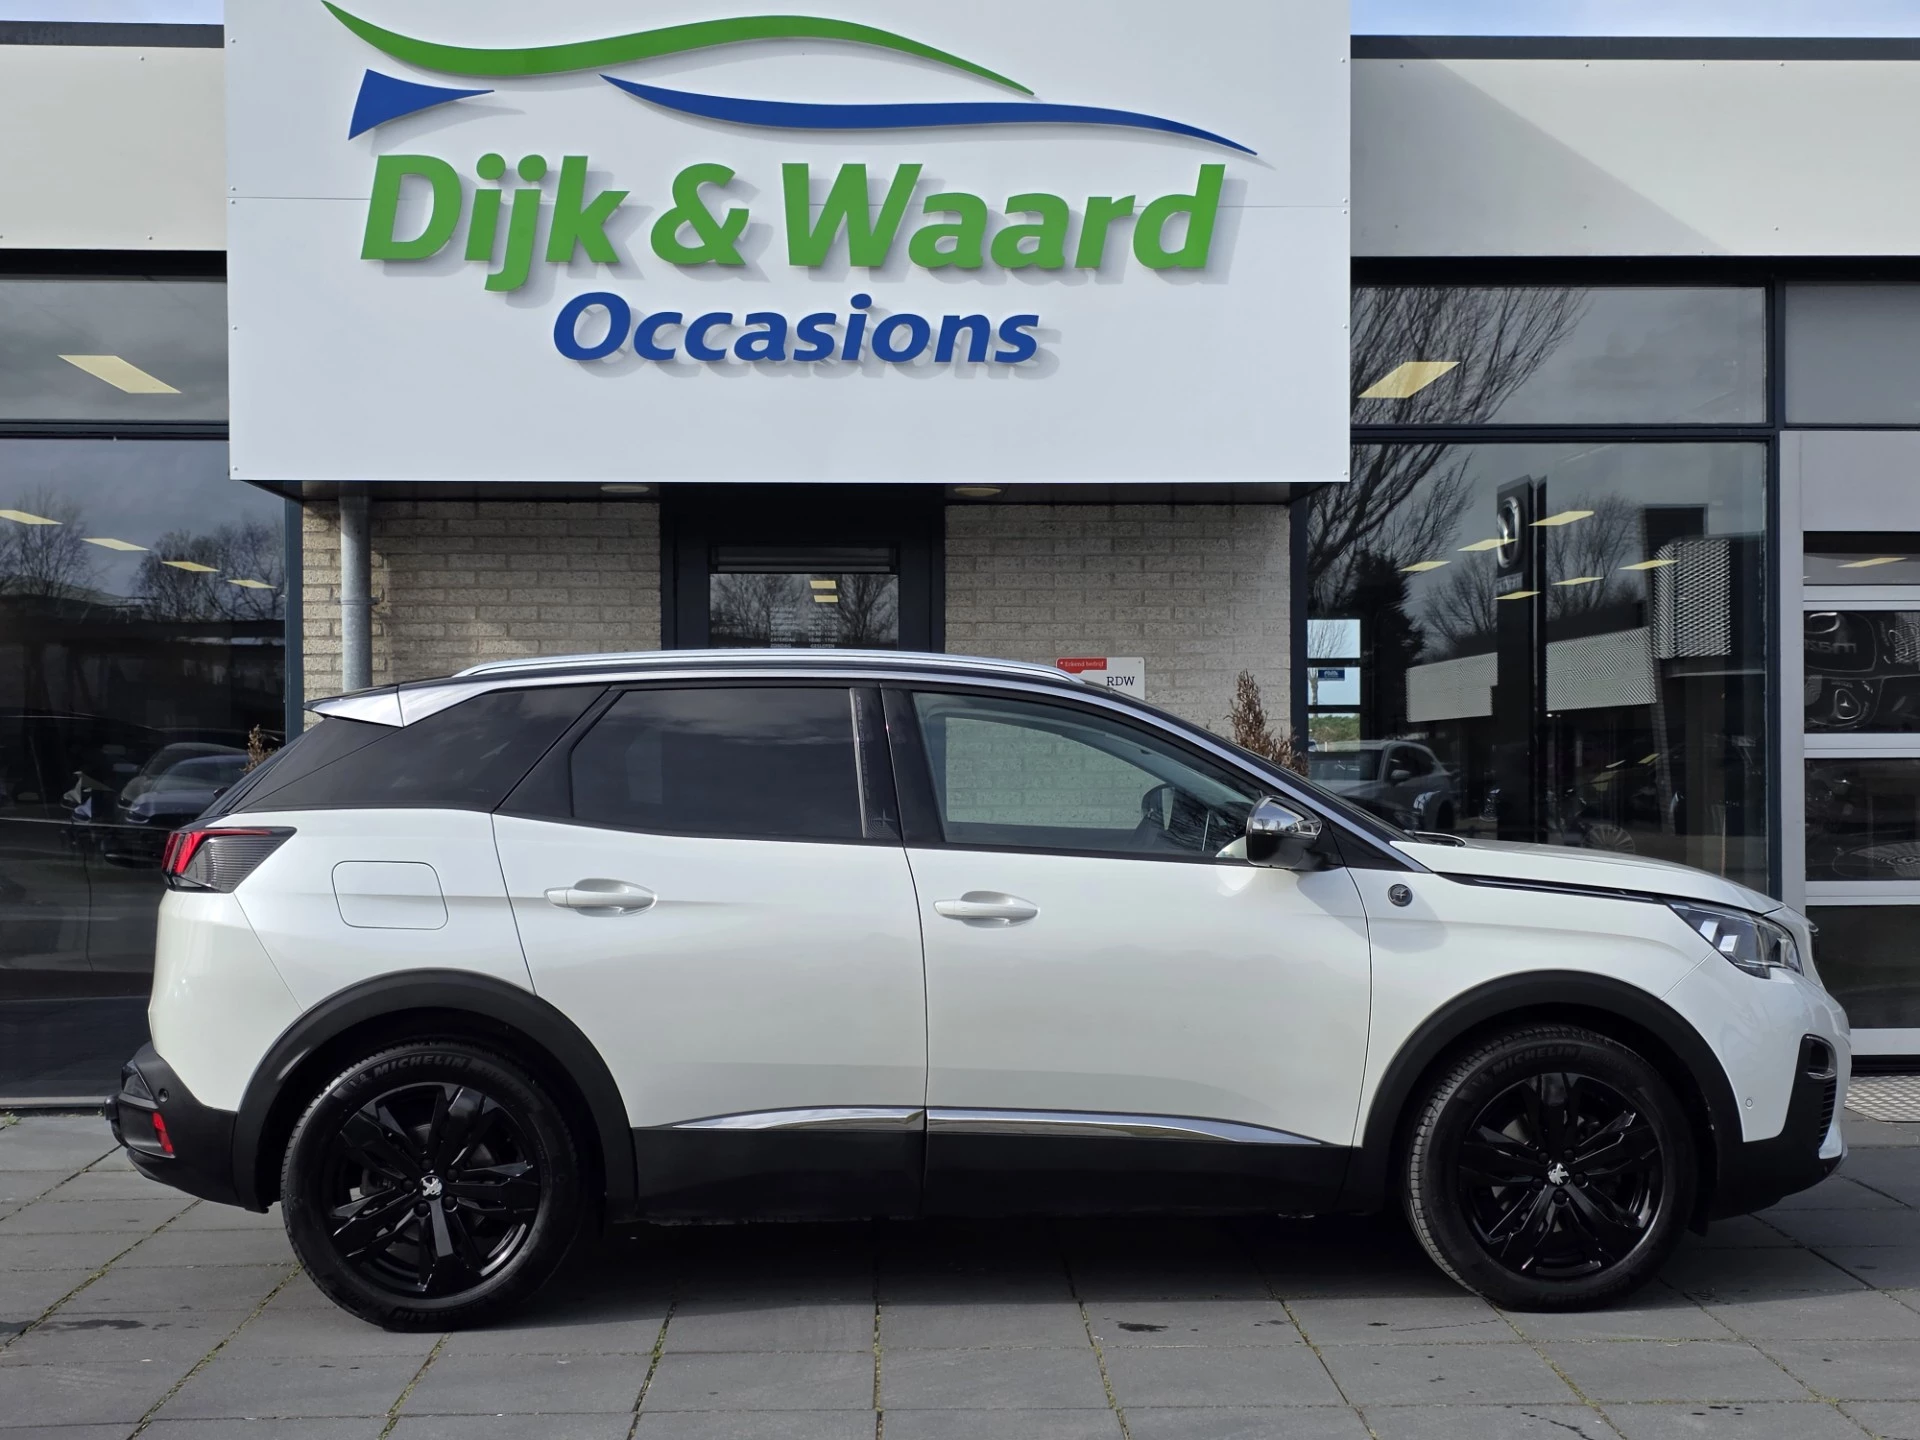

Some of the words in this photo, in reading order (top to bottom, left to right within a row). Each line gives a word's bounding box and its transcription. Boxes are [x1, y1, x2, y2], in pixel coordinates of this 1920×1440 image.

[361, 153, 630, 292] Dijk
[650, 162, 749, 266] &
[782, 163, 1226, 270] Waard
[553, 292, 1039, 364] Occasions
[1106, 676, 1135, 687] RDW
[374, 1055, 467, 1077] MICHELIN
